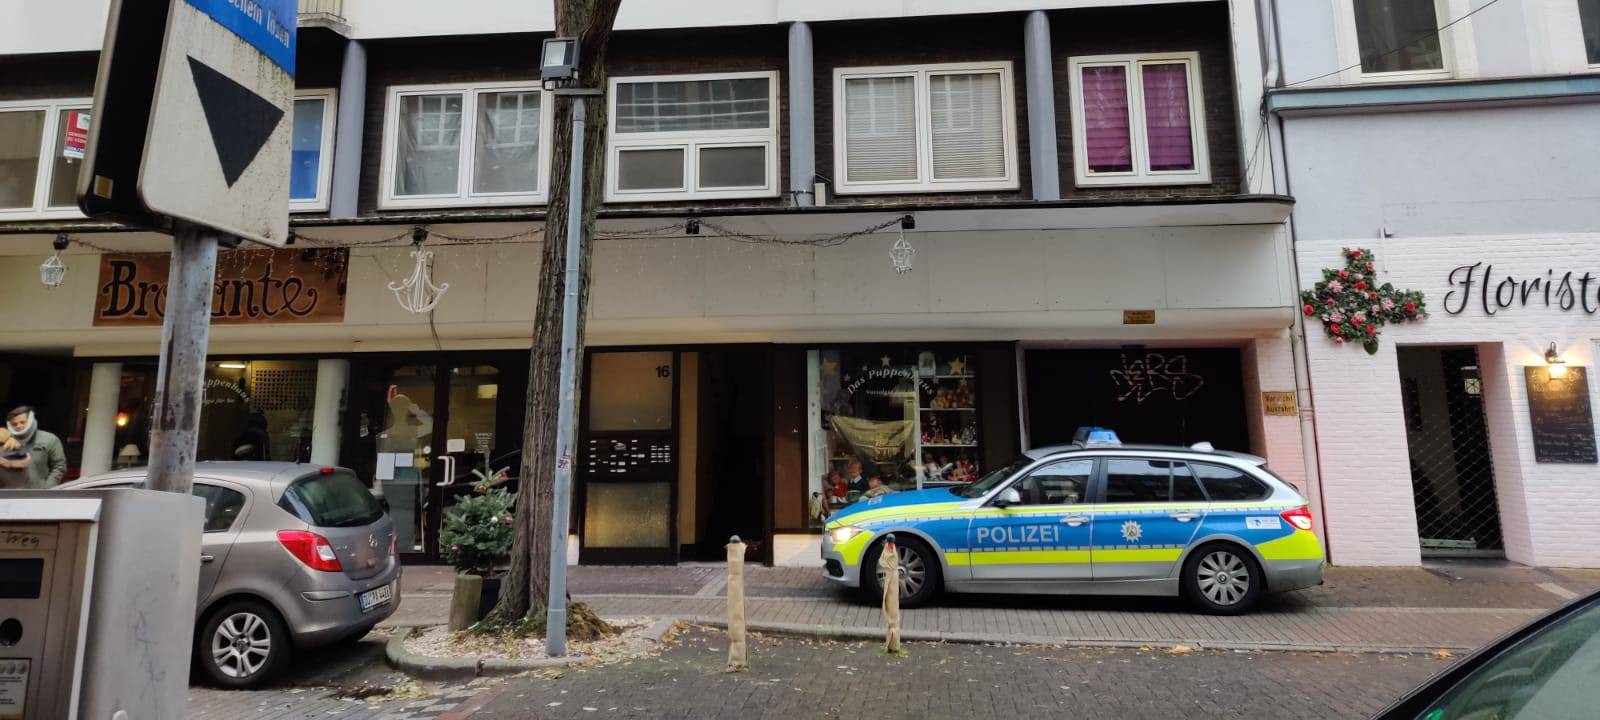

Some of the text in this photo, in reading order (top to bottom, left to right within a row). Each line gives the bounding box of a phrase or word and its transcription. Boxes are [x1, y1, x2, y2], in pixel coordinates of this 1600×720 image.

[228, 0, 263, 25] chein
[102, 259, 318, 318] Brante
[1443, 261, 1600, 316] Florist
[656, 365, 670, 378] 16
[204, 379, 249, 403] ppenhaus
[847, 376, 866, 395] Das
[977, 524, 1059, 544] POLIZEI
